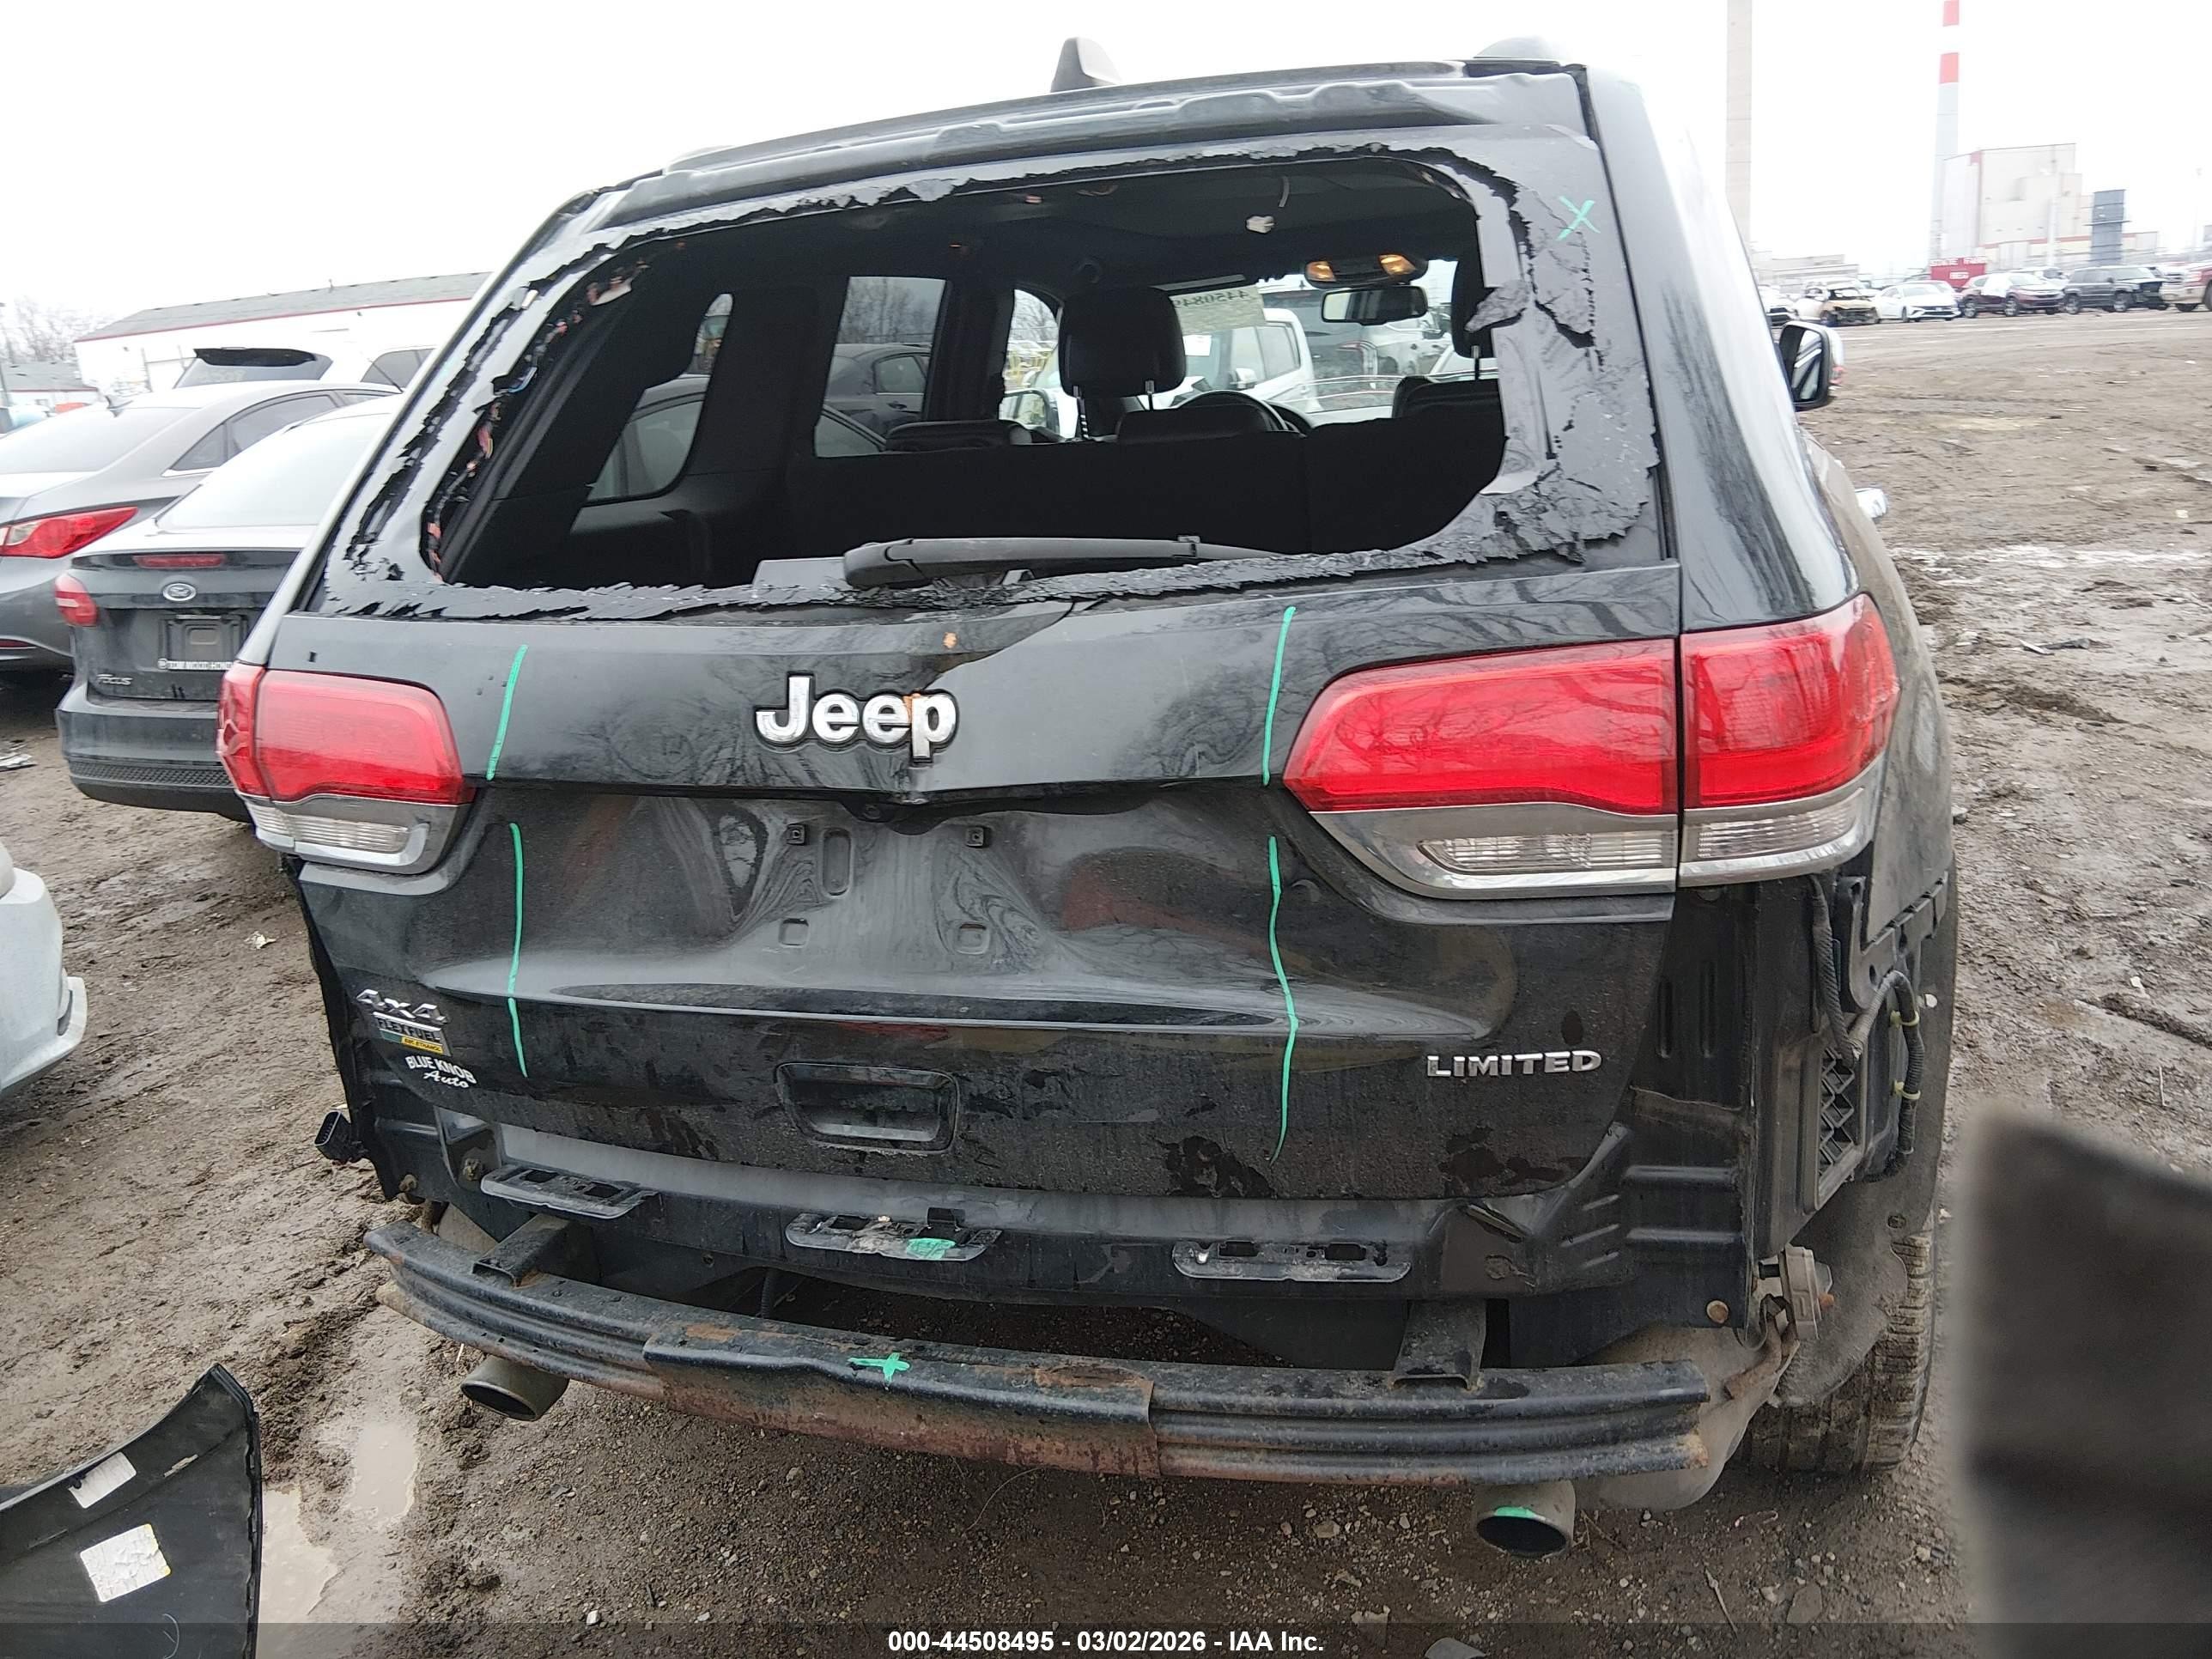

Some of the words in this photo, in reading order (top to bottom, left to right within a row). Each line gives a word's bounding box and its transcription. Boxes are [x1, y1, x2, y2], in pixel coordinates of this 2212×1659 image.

[756, 675, 957, 760] Jeep
[404, 1055, 436, 1070] BLUE
[434, 1058, 477, 1084] KNOB
[1426, 1050, 1602, 1077] LIMITED
[423, 1070, 470, 1089] Auto
